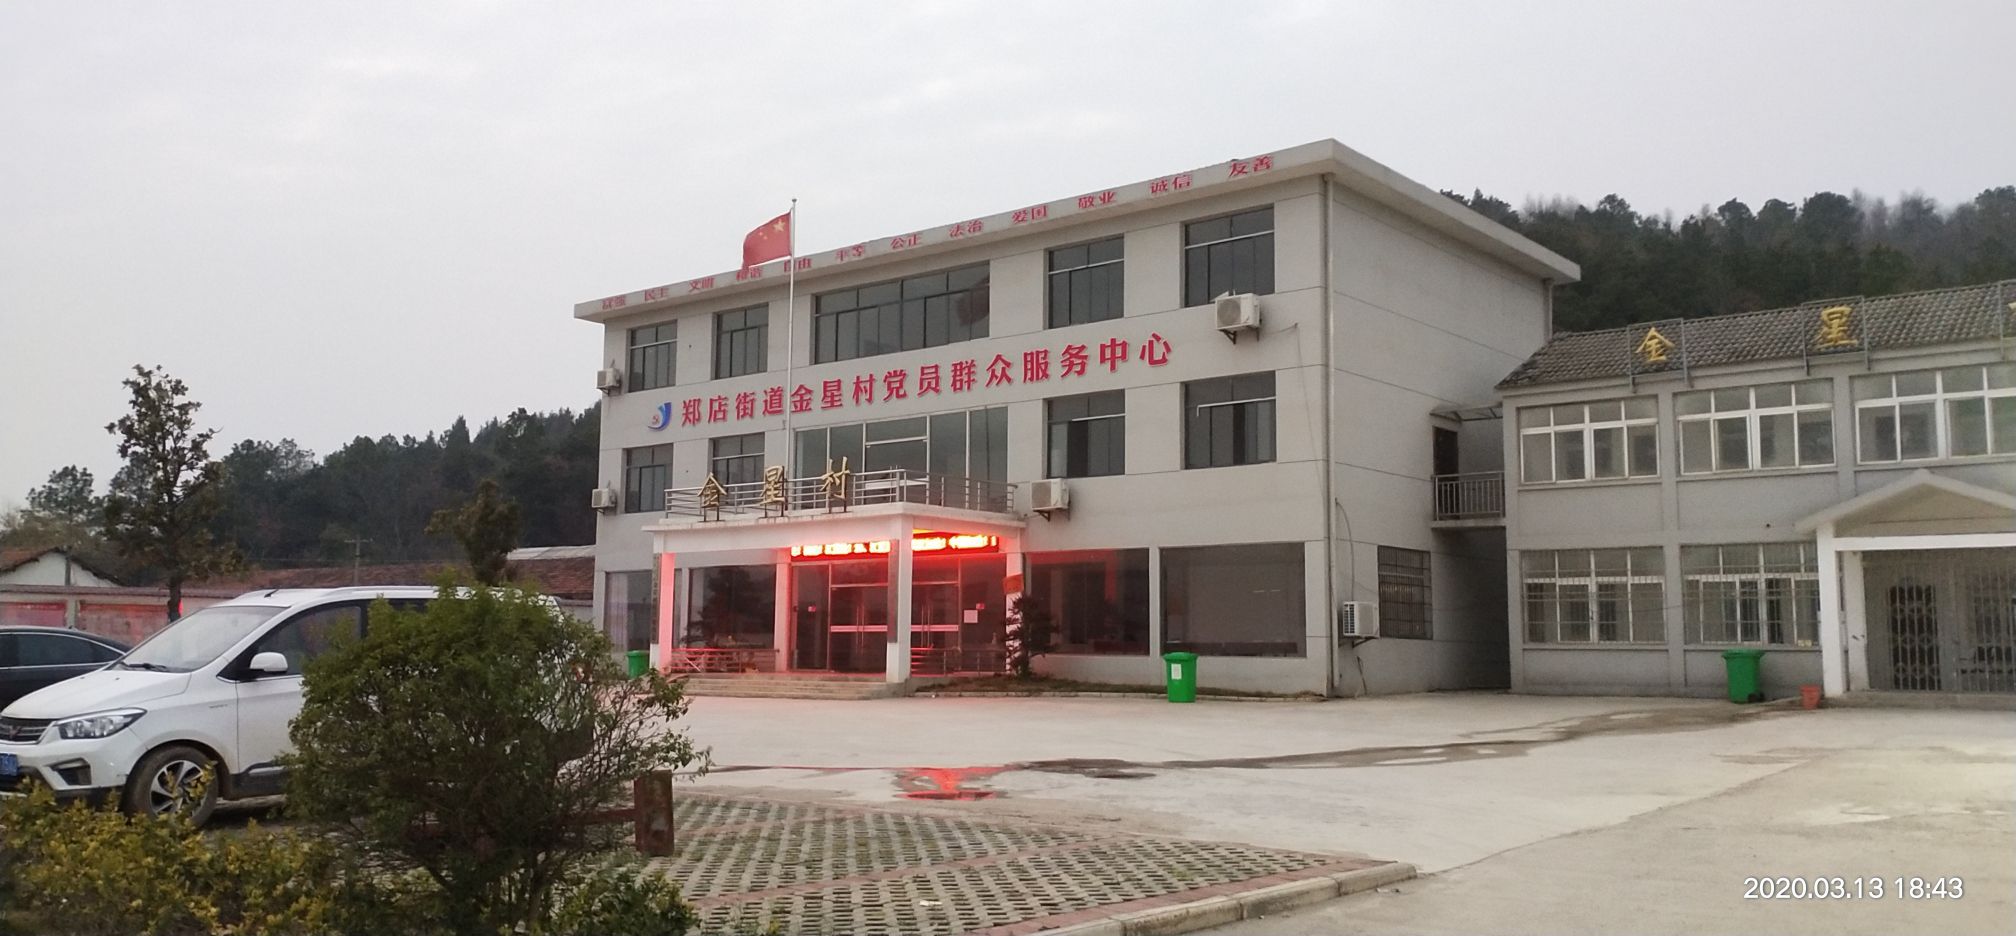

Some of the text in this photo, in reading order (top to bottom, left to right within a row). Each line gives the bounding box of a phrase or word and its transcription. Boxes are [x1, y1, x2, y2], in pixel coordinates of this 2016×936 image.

[890, 233, 922, 251] 公正
[948, 219, 985, 239] 法治
[1011, 203, 1049, 225] 爱国
[1077, 190, 1117, 211] 敬业
[1148, 173, 1194, 195] 诚信
[1227, 154, 1275, 178] 友善
[679, 331, 1174, 427] 郑店街道金星村党员群众服务中心
[697, 455, 852, 509] 金星村
